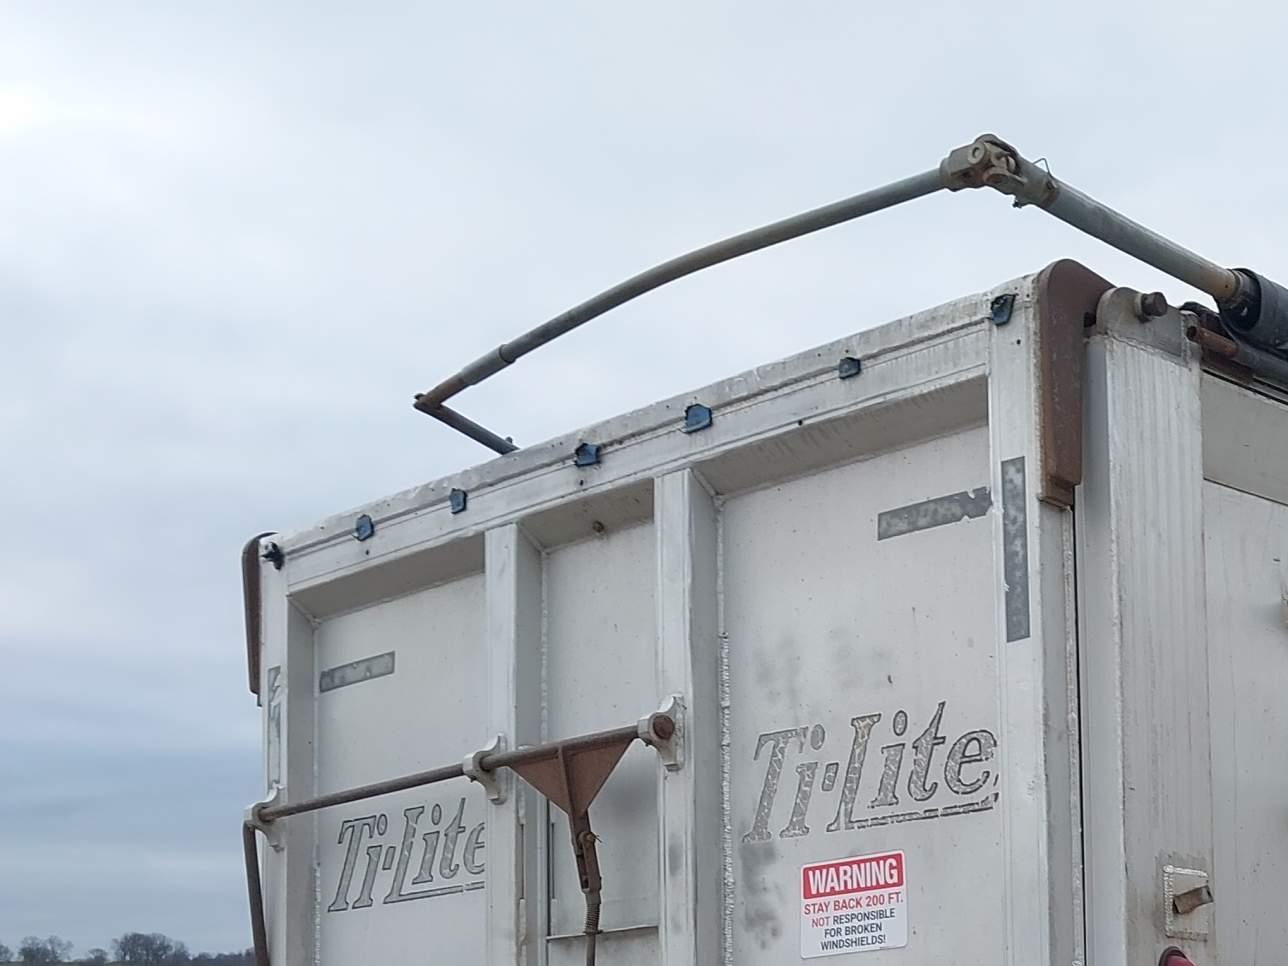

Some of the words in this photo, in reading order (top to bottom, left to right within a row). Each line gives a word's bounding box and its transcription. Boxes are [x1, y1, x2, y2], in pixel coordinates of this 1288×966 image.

[808, 858, 898, 895] WARNING
[804, 901, 831, 915] STAY
[833, 896, 863, 912] BACK
[865, 893, 885, 907] 200
[888, 891, 904, 904] FT.
[811, 916, 831, 928] NOT
[833, 907, 896, 925] RESPONSIBLE
[824, 927, 842, 938] FOR
[844, 922, 883, 936] BROKEN
[820, 934, 886, 951] WINDSHIELDS!
